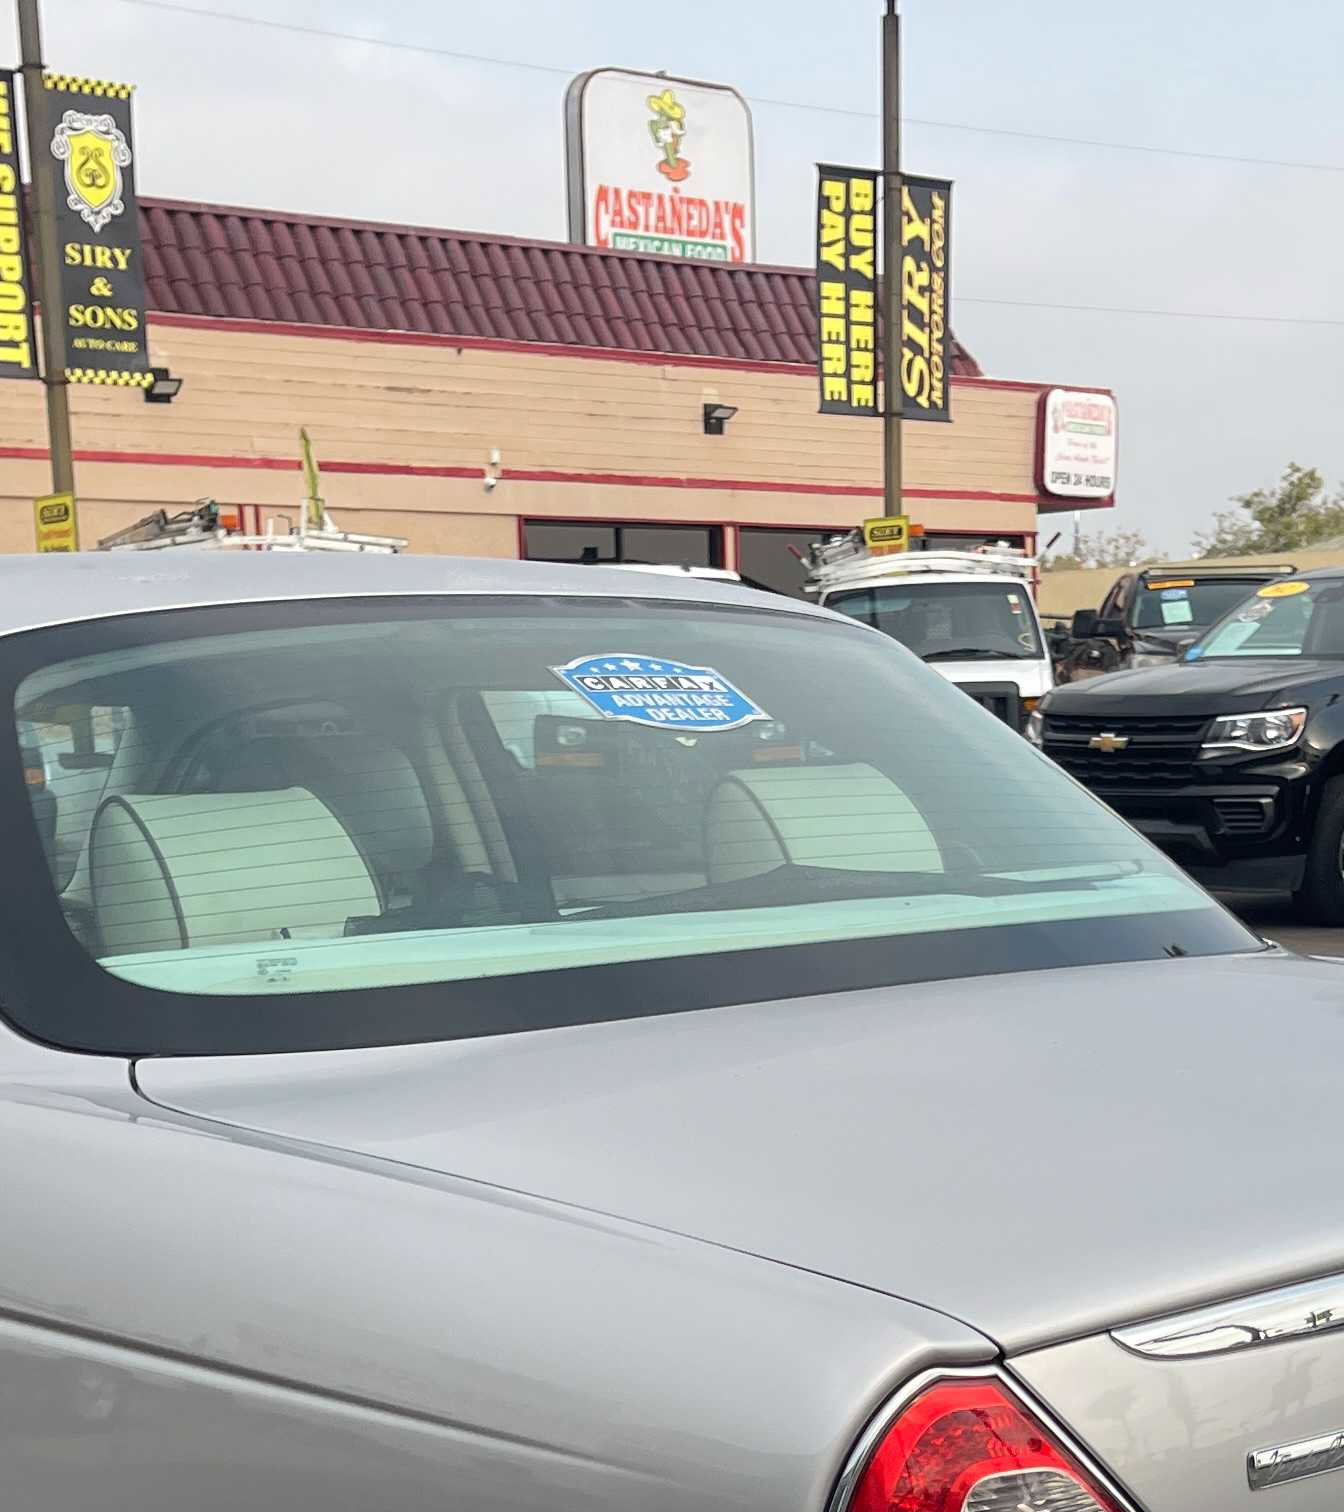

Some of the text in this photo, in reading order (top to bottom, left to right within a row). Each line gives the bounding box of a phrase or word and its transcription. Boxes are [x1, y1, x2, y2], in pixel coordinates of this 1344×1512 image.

[64, 242, 132, 270] SIRY
[90, 276, 113, 297] &
[820, 179, 847, 402] PAY HERE
[849, 178, 874, 408] BUY HERE
[900, 184, 931, 409] SIRY
[929, 190, 947, 409] MOTORS.COM
[68, 304, 138, 331] SONS
[581, 676, 722, 692] CARFAX
[611, 694, 736, 707] ADVANTAGE
[646, 708, 732, 721] DEALER
